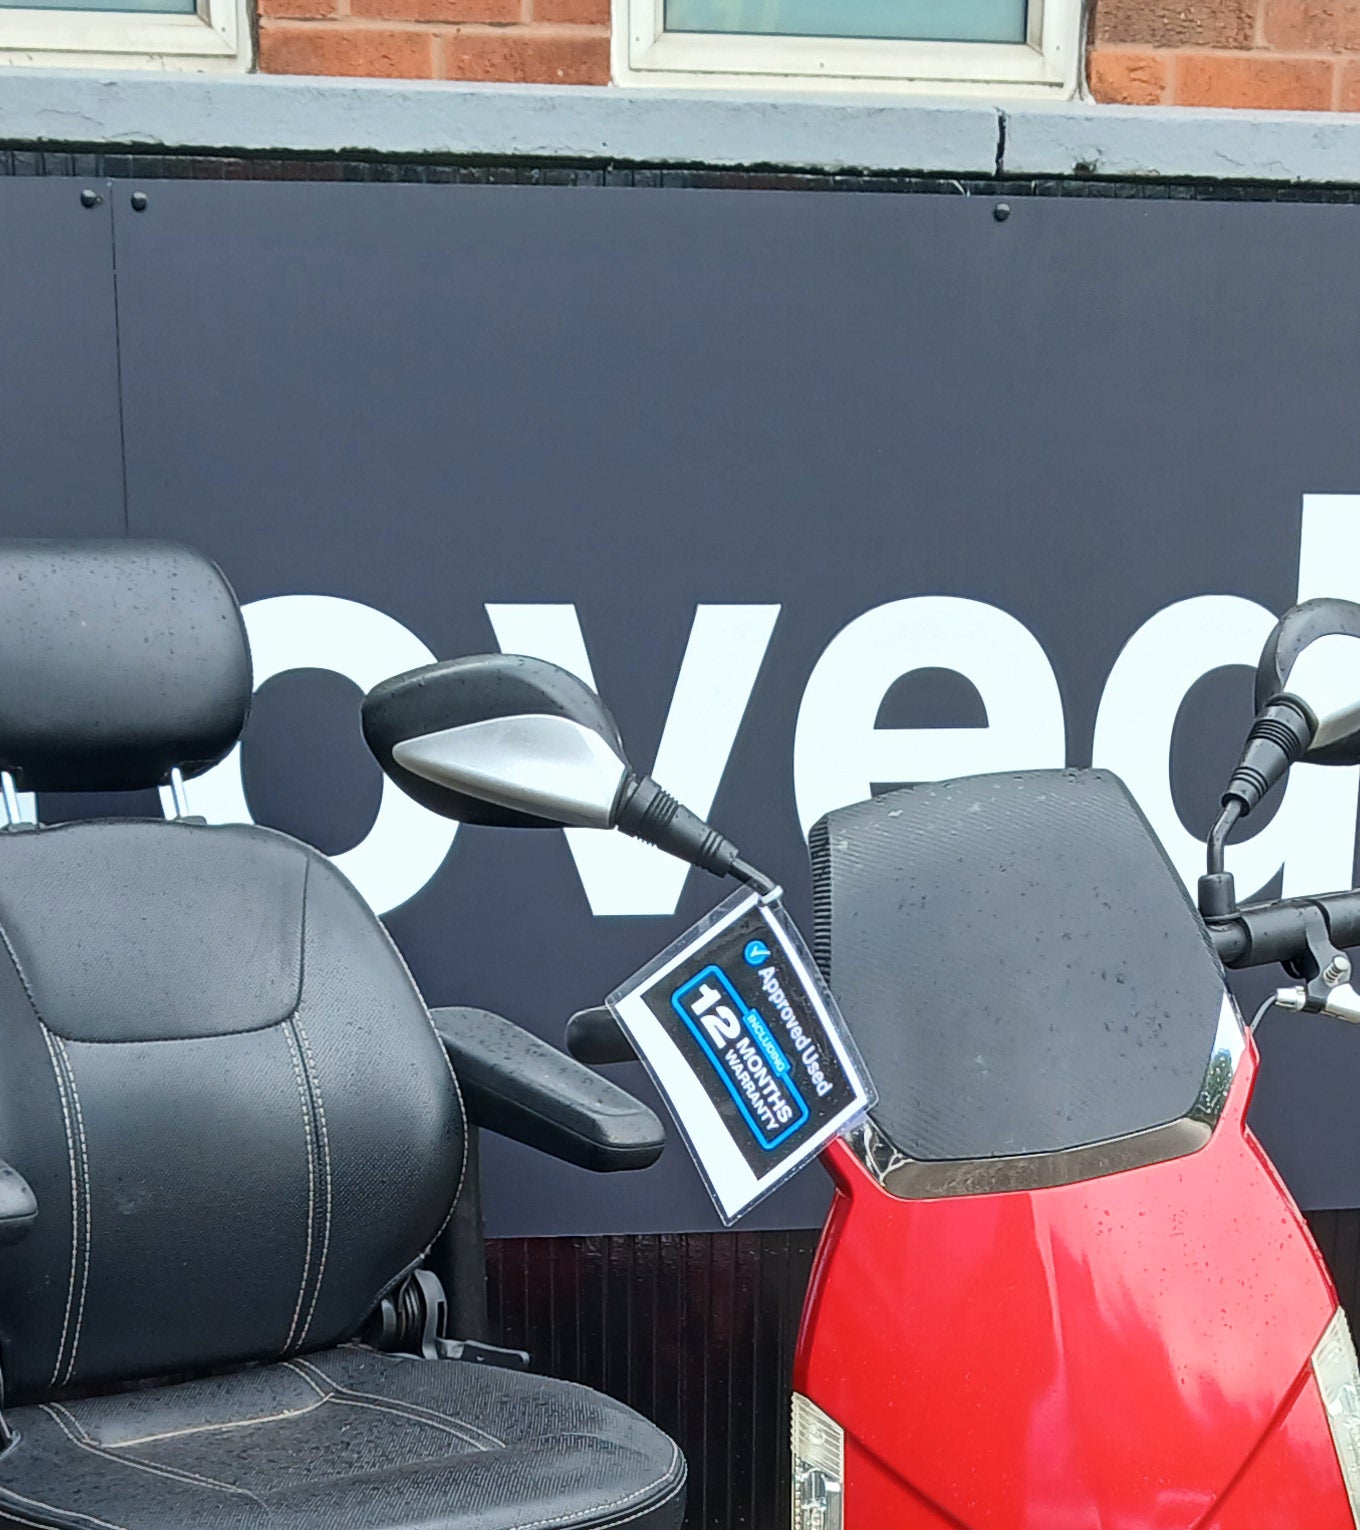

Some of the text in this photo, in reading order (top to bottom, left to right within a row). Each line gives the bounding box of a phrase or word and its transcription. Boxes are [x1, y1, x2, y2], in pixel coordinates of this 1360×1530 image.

[690, 983, 793, 1123] 12 MONTHS
[747, 1014, 786, 1073] INCLUDING
[758, 966, 833, 1096] Approved Used
[724, 1050, 779, 1131] WARRANTY
